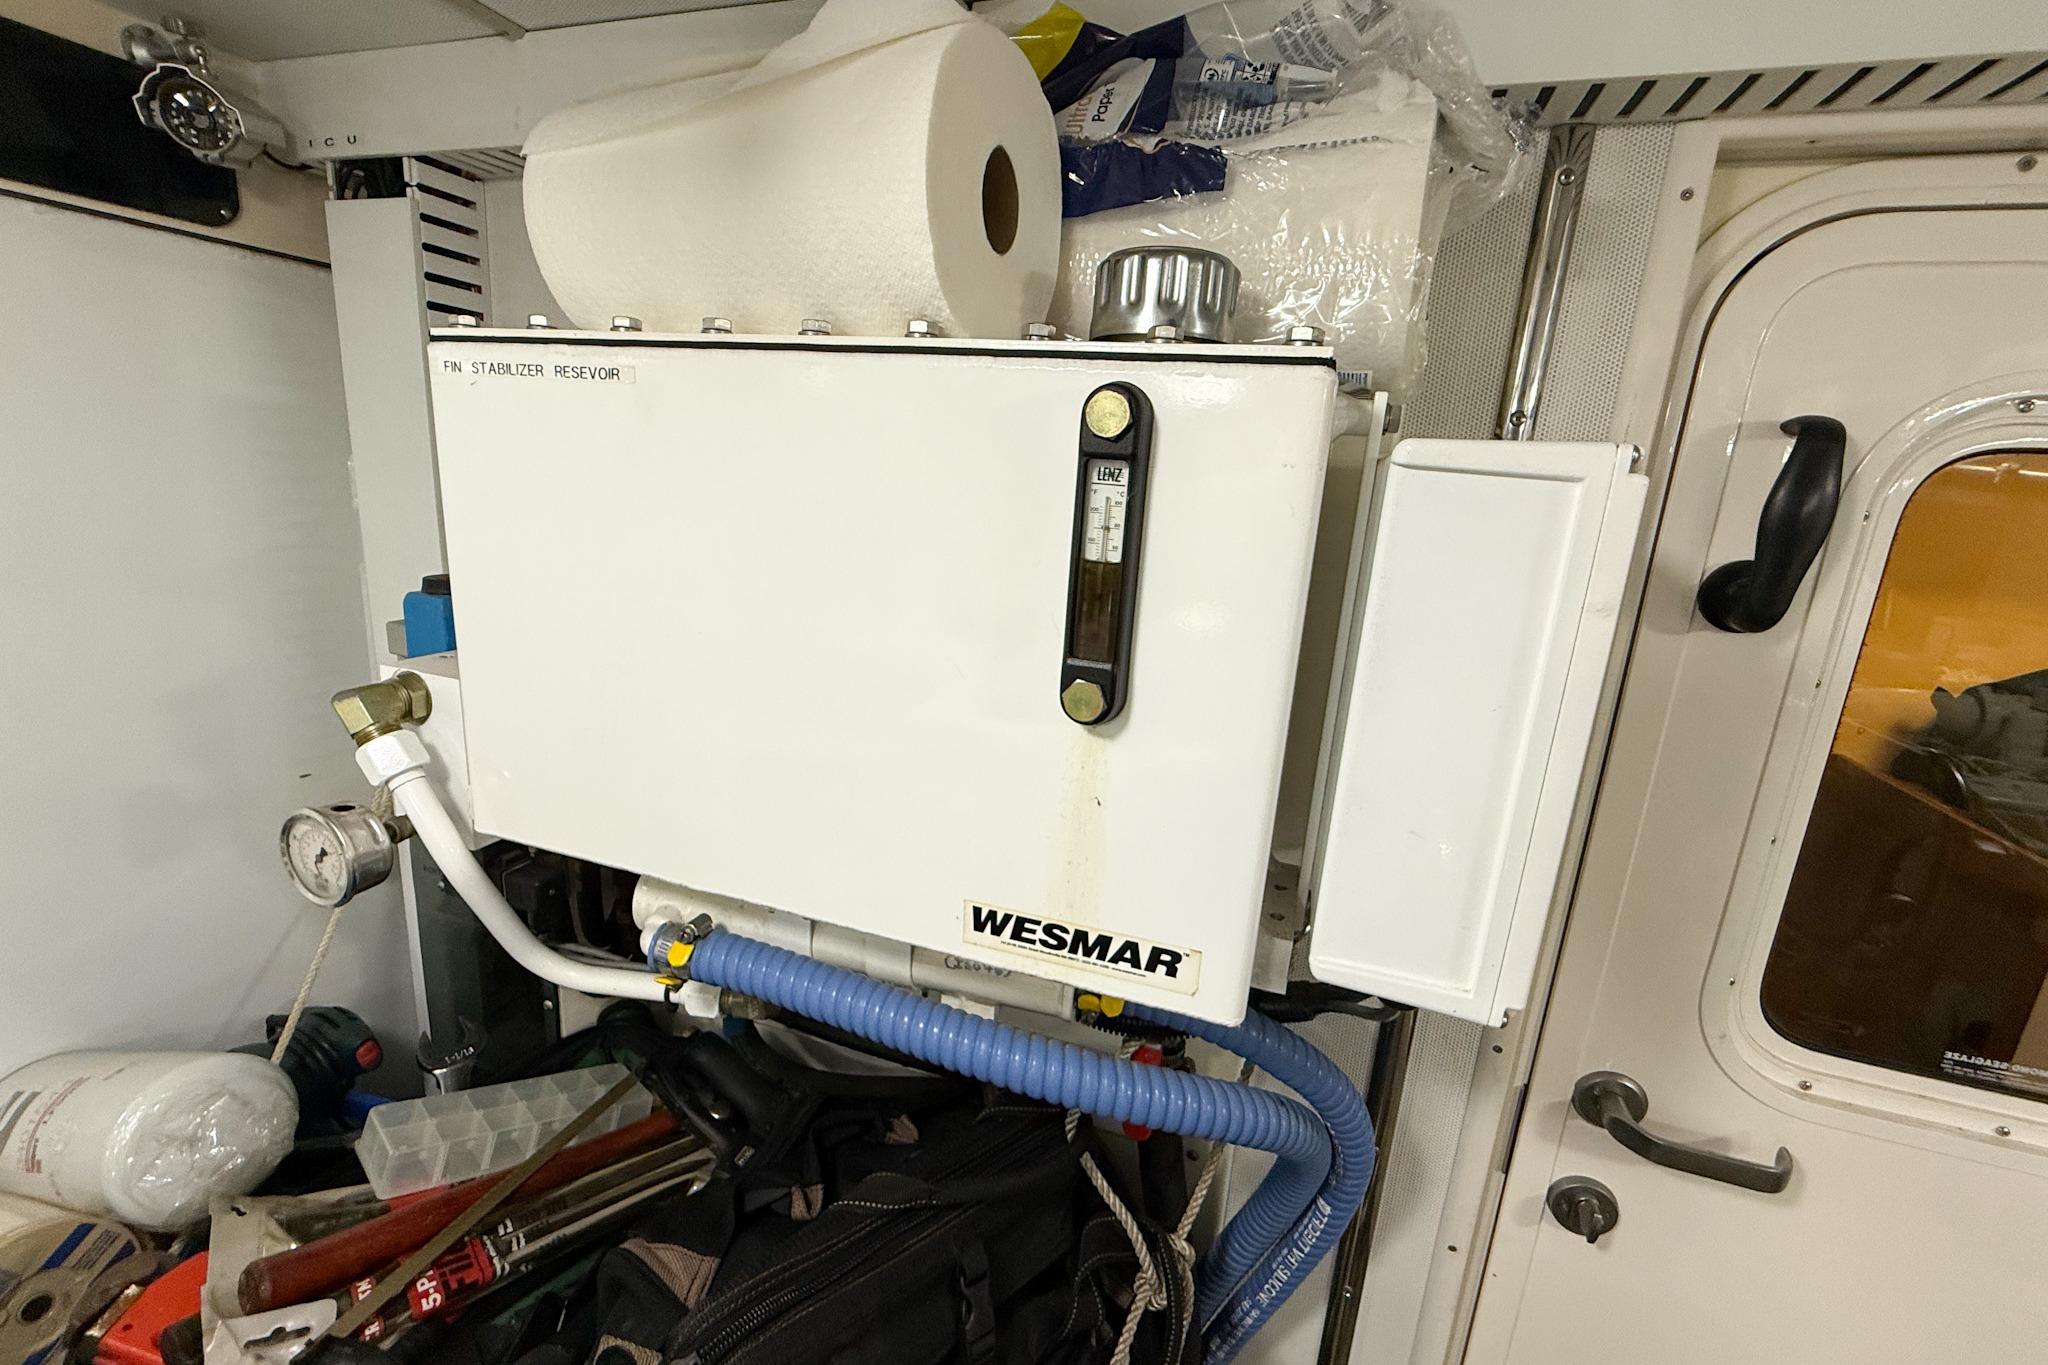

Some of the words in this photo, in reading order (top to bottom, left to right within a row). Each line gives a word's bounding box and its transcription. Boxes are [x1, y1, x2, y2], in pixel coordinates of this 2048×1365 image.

[443, 360, 462, 373] FIN
[471, 361, 544, 377] STABILIZER
[554, 365, 621, 381] RESEVOIR
[1097, 466, 1123, 482] LENZ
[972, 905, 1183, 979] WESMAR
[1298, 1210, 1329, 1254] TRIDENT
[1255, 1264, 1291, 1308] SILICONE
